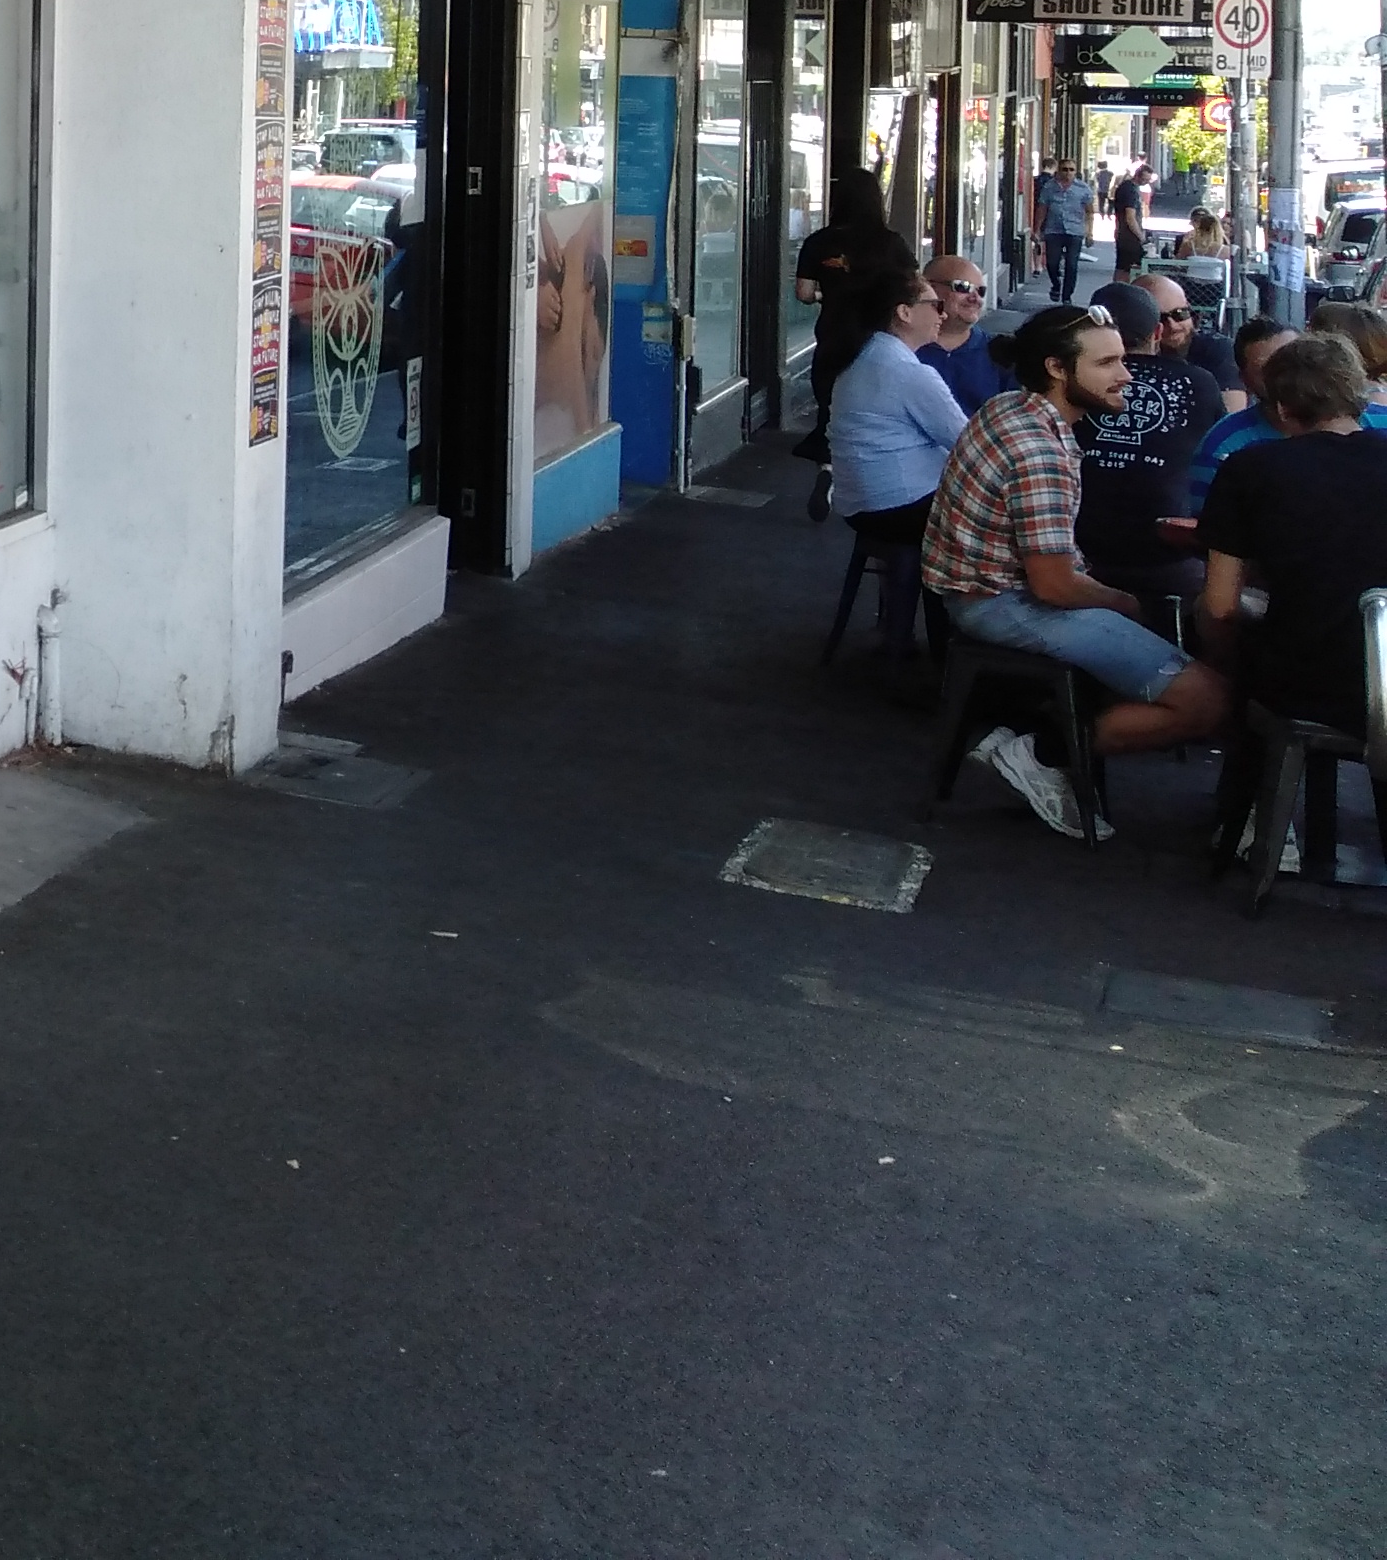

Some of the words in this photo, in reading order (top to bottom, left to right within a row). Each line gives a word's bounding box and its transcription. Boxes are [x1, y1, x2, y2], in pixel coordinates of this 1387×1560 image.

[1223, 5, 1261, 32] 40
[1216, 54, 1227, 70] 8
[1100, 414, 1150, 429] CAT
